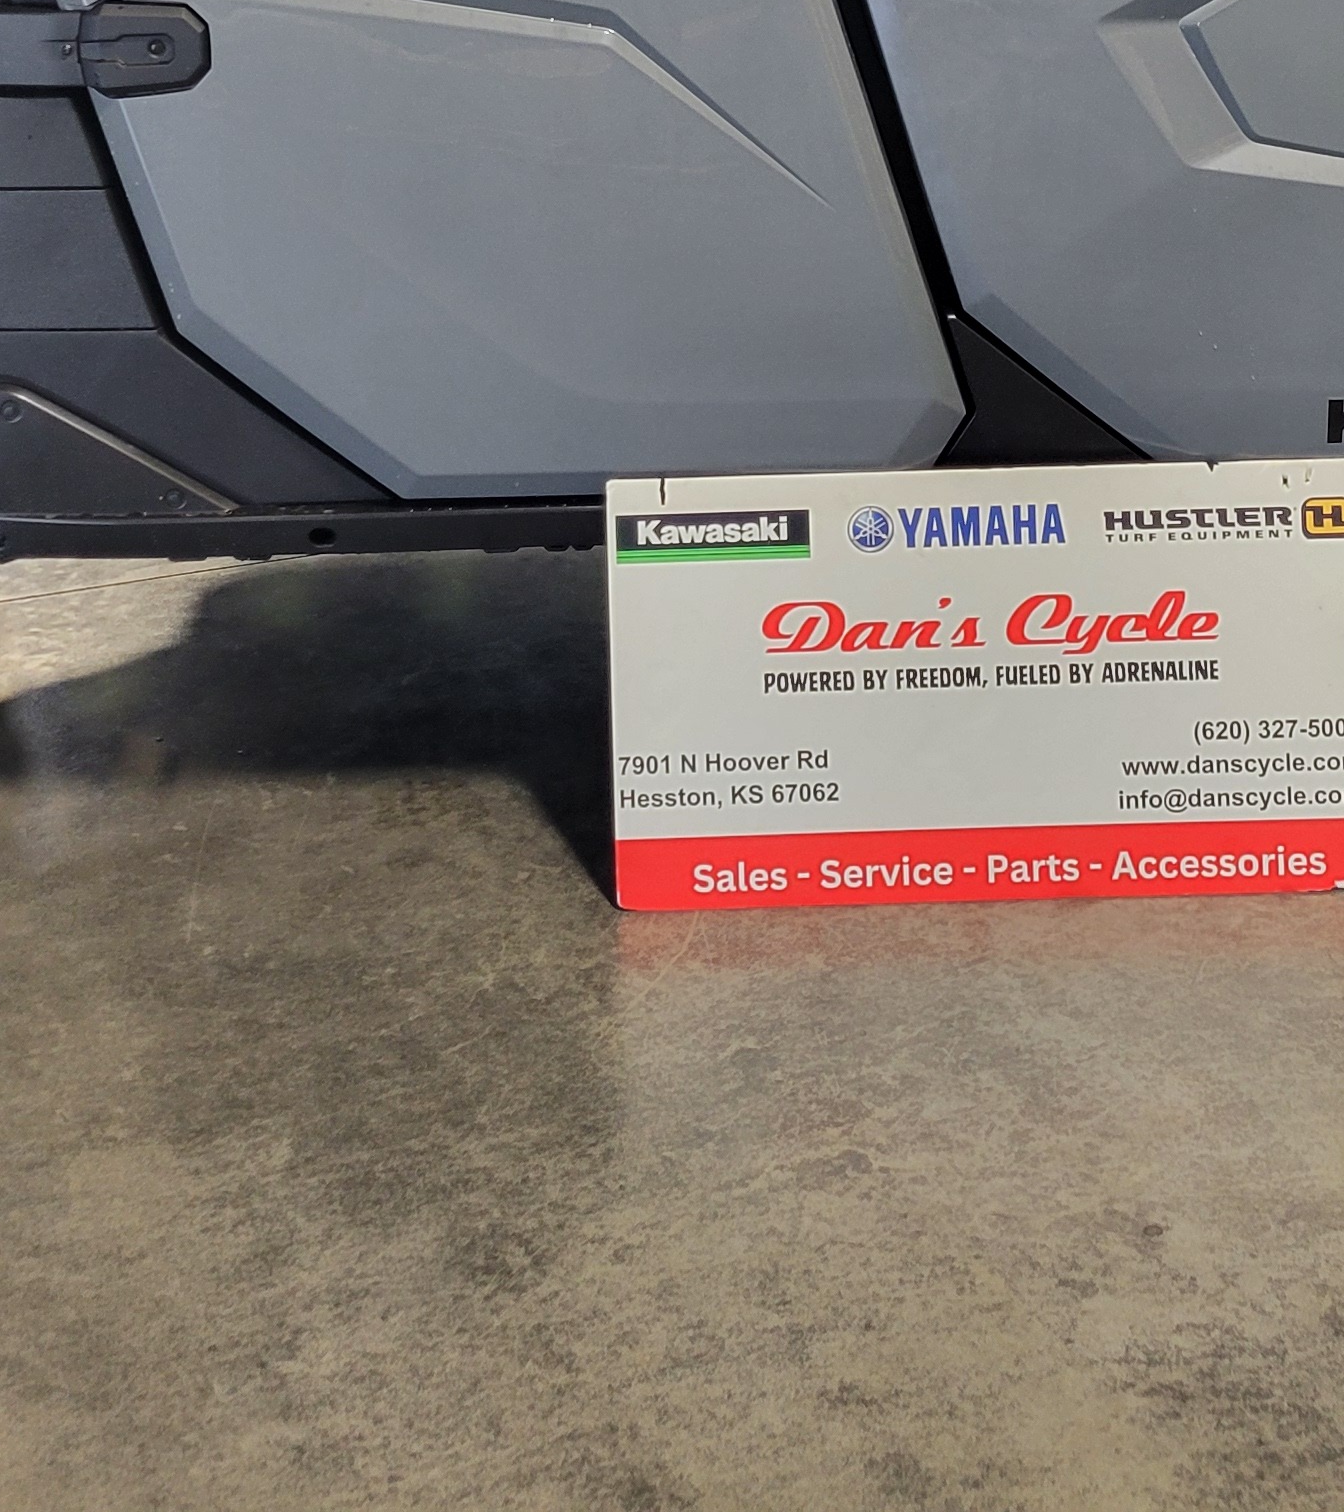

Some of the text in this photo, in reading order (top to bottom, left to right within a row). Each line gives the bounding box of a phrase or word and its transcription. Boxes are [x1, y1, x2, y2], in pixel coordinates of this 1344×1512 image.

[636, 515, 789, 546] Kawasaki
[896, 503, 1067, 548] YAMAHA
[1103, 506, 1293, 531] HUSTLER
[1105, 529, 1293, 544] TURF EQUIPMENT
[761, 590, 1220, 656] Dan's Cycle
[763, 659, 1220, 695] POWERED BY FREEDOM, FUELED BY ADRENALINE
[1193, 719, 1251, 746] (620)
[618, 749, 829, 776] 7901 N Hoover Rd
[619, 782, 840, 809] Hesston, KS 67062
[692, 861, 789, 894] Sales
[819, 855, 954, 889] Service
[986, 853, 1081, 884] Parts
[1111, 845, 1328, 881] Accessories
